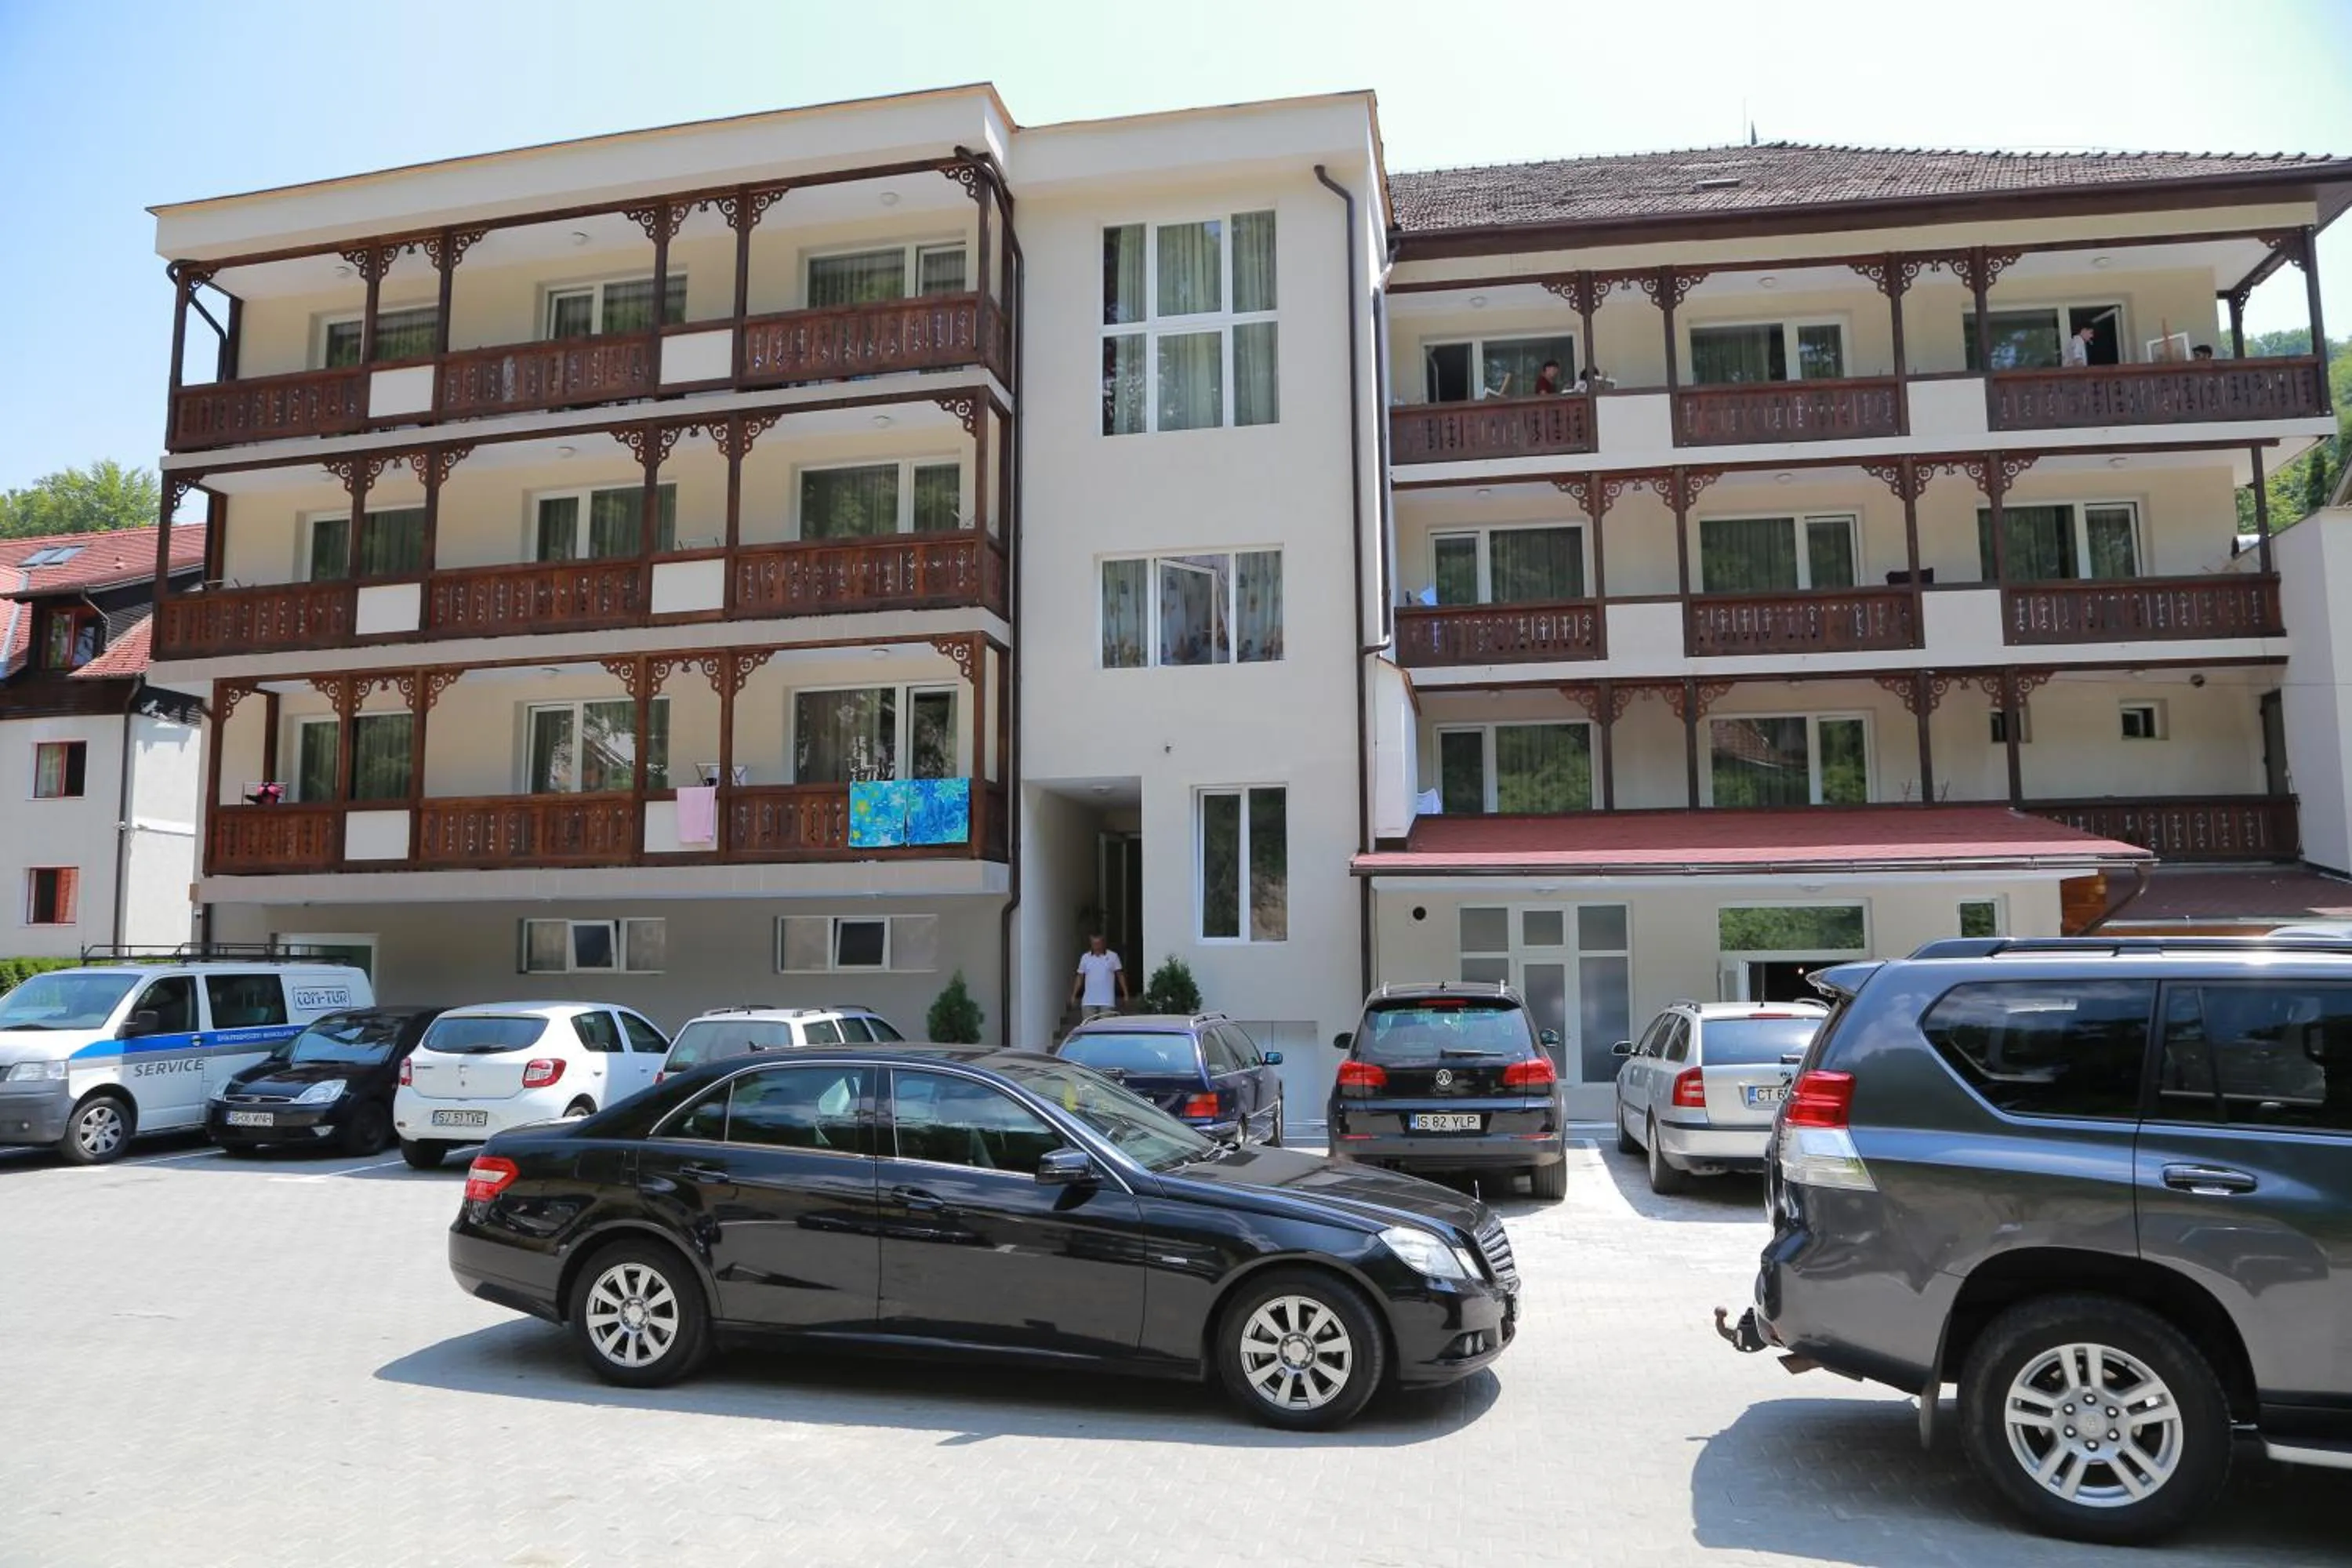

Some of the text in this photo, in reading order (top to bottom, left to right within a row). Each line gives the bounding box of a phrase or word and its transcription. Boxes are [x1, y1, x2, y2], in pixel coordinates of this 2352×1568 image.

[134, 1058, 204, 1077] SERVICE
[1757, 1089, 1773, 1102] CT
[466, 1112, 484, 1123] TVE
[1416, 1116, 1476, 1128] IS 82 YLP
